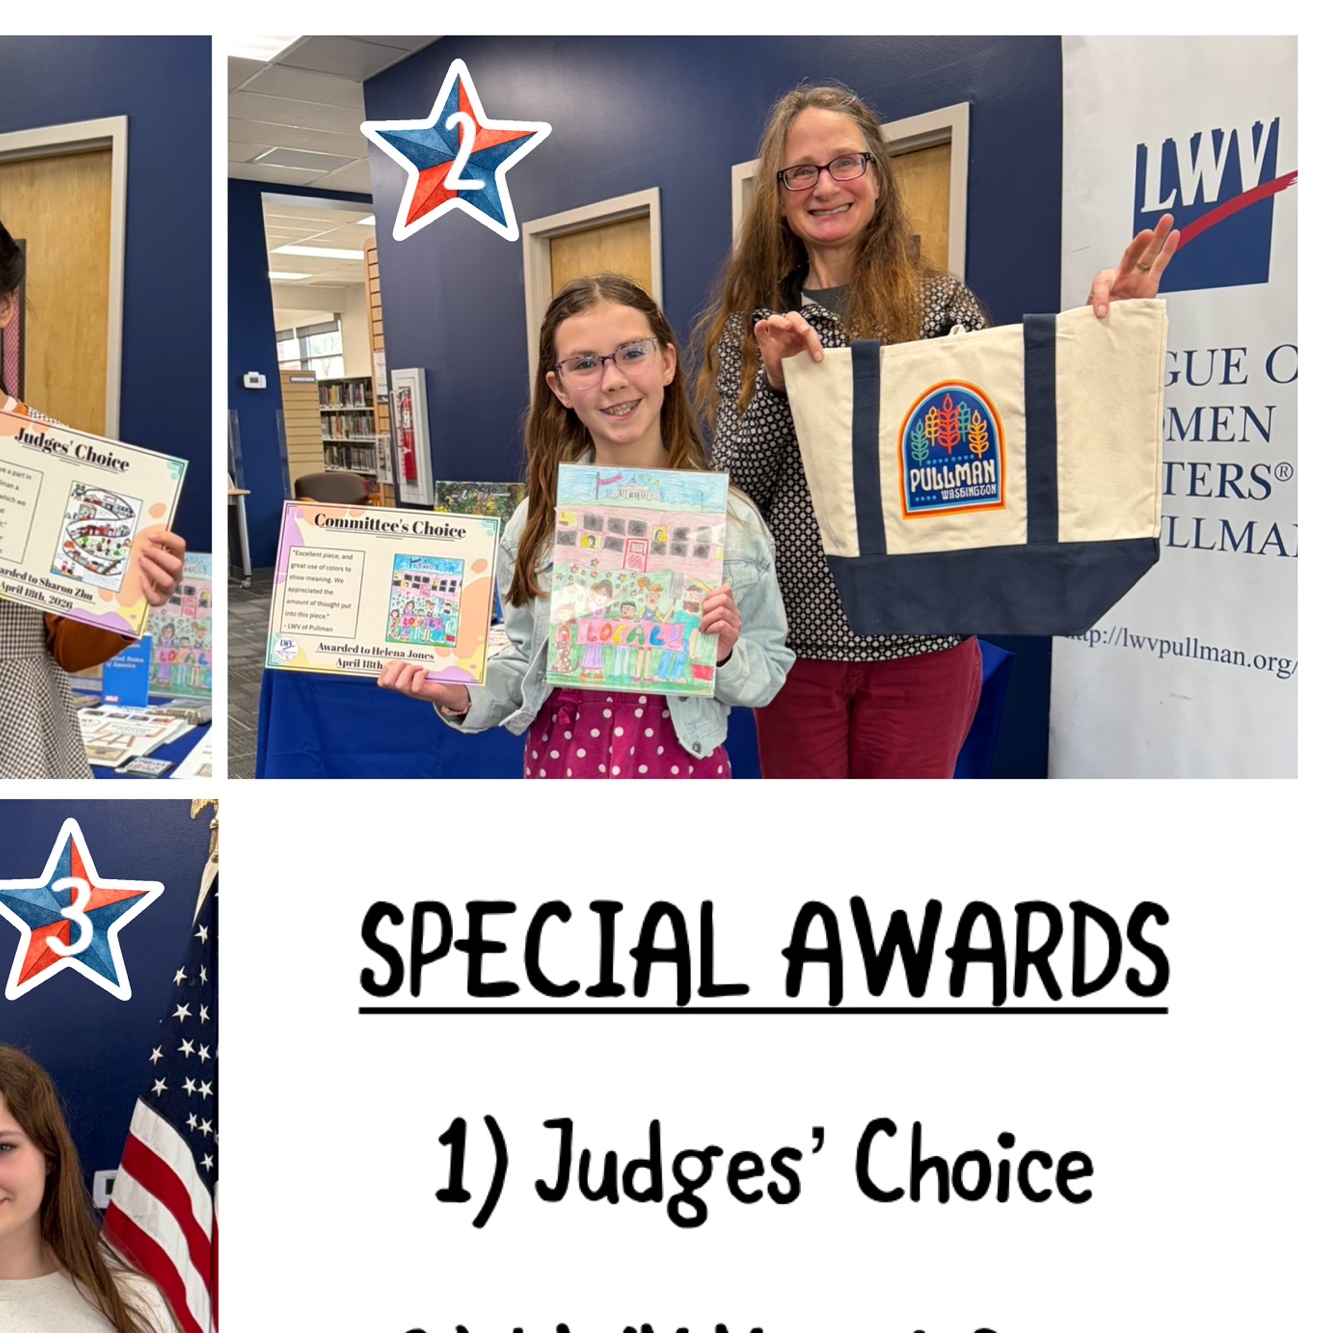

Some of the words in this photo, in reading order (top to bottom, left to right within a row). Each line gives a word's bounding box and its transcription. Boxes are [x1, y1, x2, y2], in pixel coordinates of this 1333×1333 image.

[75, 442, 130, 472] Choice
[910, 459, 997, 493] PULLMAN
[941, 483, 997, 501] WASHINGTON
[314, 513, 409, 535] Committee's
[412, 519, 466, 539] Choice
[0, 580, 25, 598] April
[48, 593, 73, 610] 2026
[28, 573, 37, 584] to
[39, 575, 73, 596] Sharon
[74, 587, 93, 601] Zhu
[317, 642, 359, 655] Awarded
[360, 646, 370, 655] to
[372, 646, 405, 659] Helena
[407, 649, 434, 660] Jones
[336, 657, 360, 671] April
